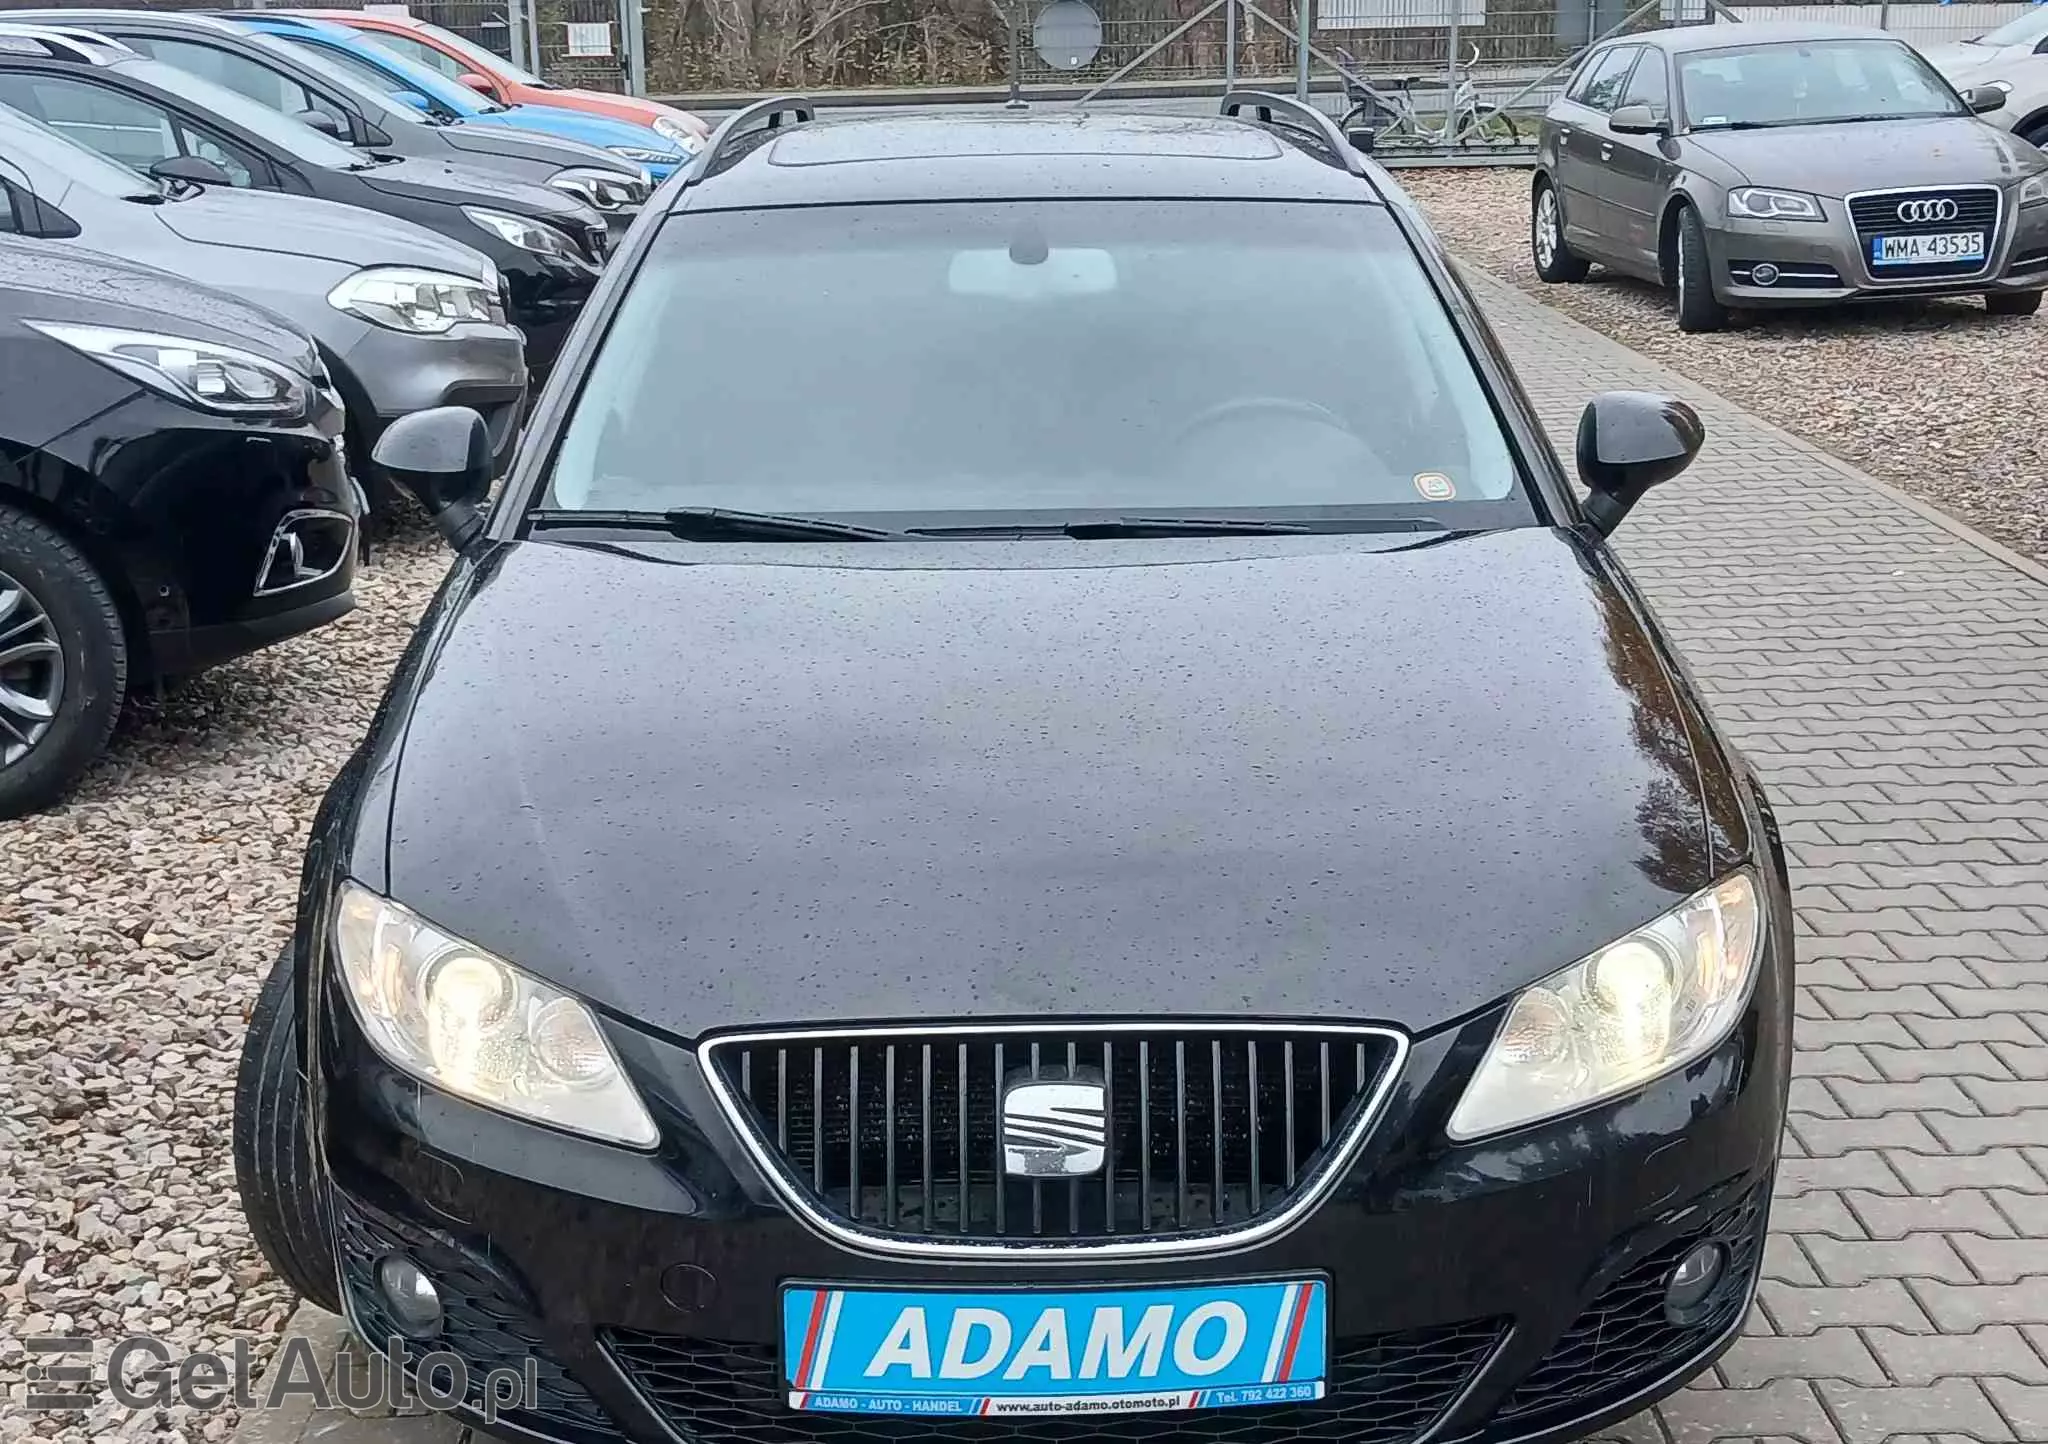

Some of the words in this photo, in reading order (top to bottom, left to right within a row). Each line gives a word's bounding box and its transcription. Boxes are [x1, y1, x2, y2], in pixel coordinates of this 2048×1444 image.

[1884, 237, 1920, 258] WMA
[1926, 234, 1981, 256] 43535
[862, 1300, 1248, 1380] ADAMO
[1240, 1389, 1262, 1401] 792
[1265, 1387, 1287, 1399] 422
[1289, 1385, 1312, 1397] 360
[814, 1396, 858, 1409] ADAMO
[868, 1399, 902, 1411] AUTO
[912, 1400, 962, 1412] HANDEL
[996, 1395, 1181, 1412] www.auto-adamo.otomoto.pl
